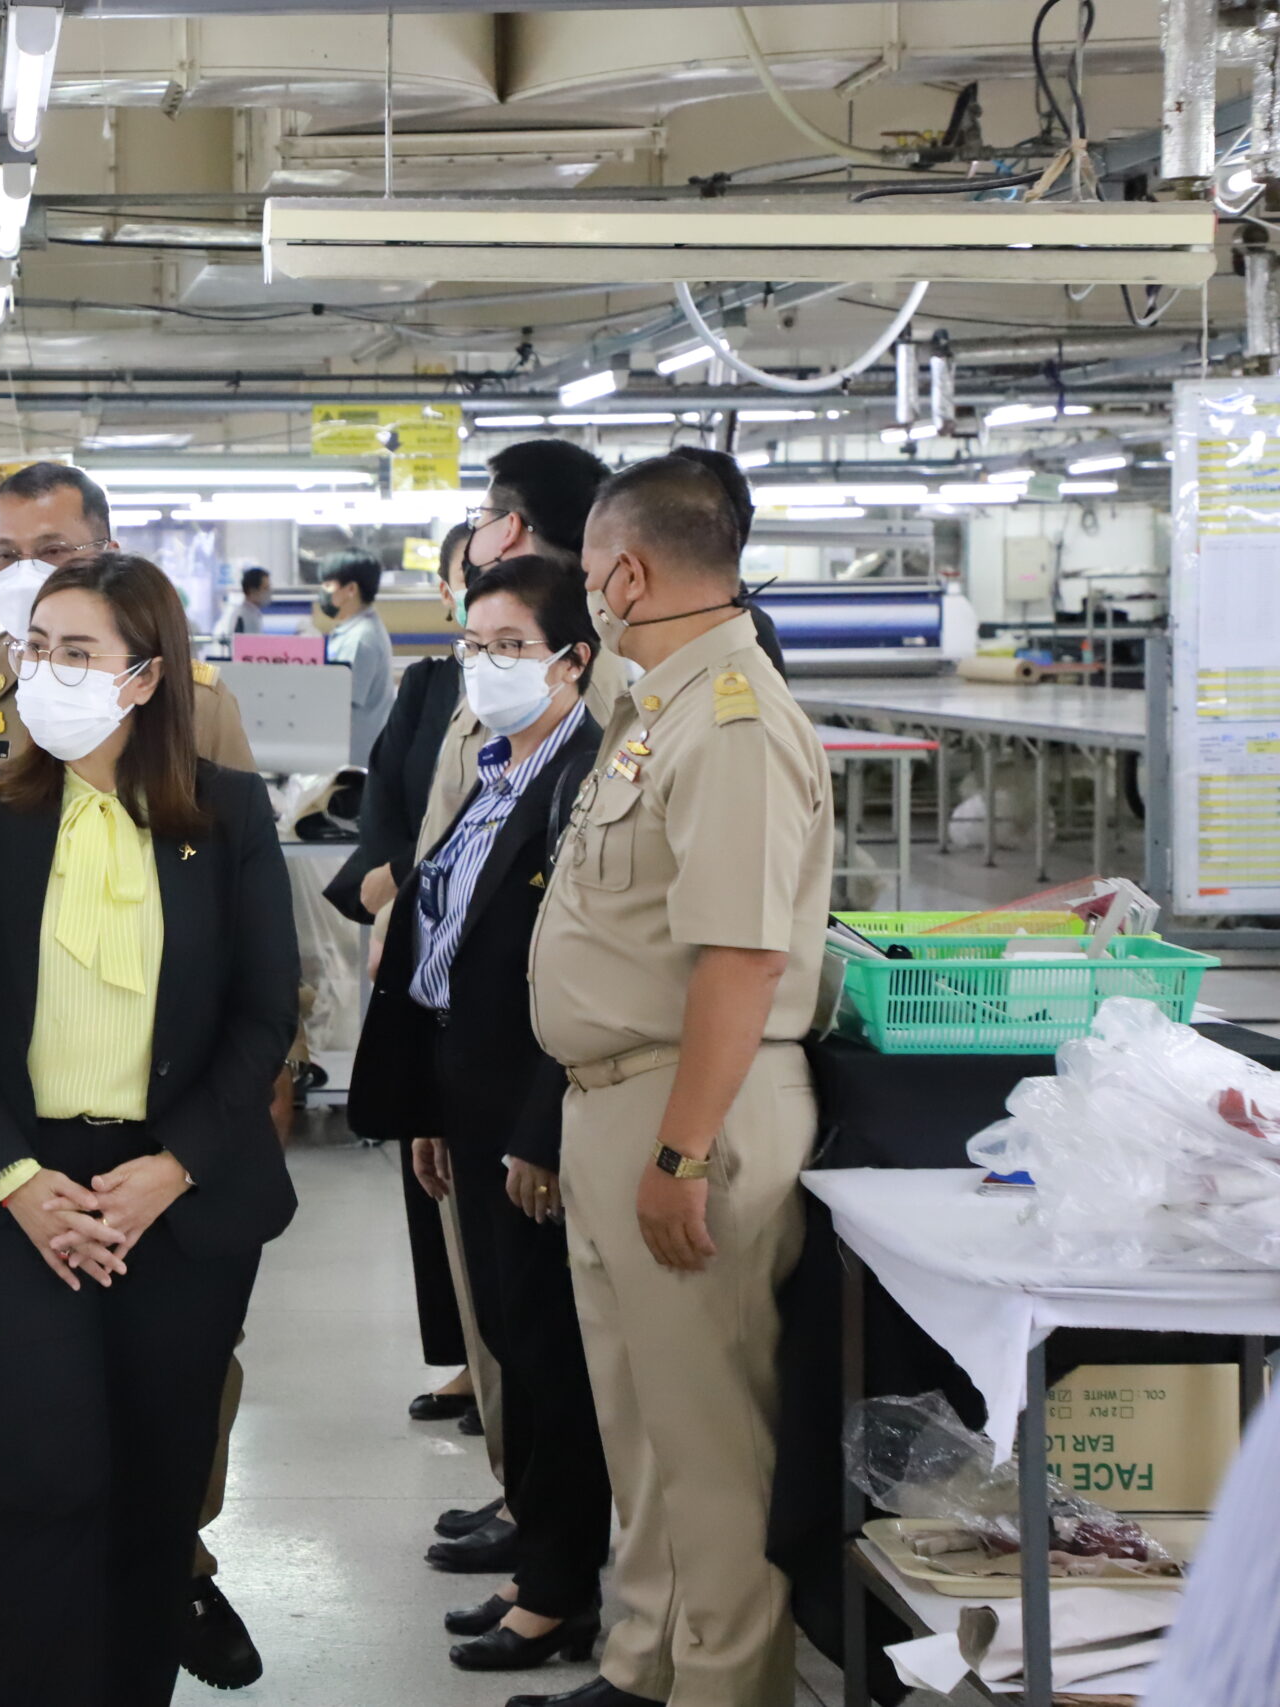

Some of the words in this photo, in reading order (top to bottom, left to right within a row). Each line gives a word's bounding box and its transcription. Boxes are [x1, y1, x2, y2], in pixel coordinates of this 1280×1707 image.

[1045, 1390, 1056, 1401] B
[1083, 1389, 1118, 1401] WHITE
[1089, 1407, 1109, 1418] PLY
[1111, 1407, 1118, 1417] 2
[1072, 1434, 1115, 1453] EAR
[1072, 1463, 1154, 1491] FACE
